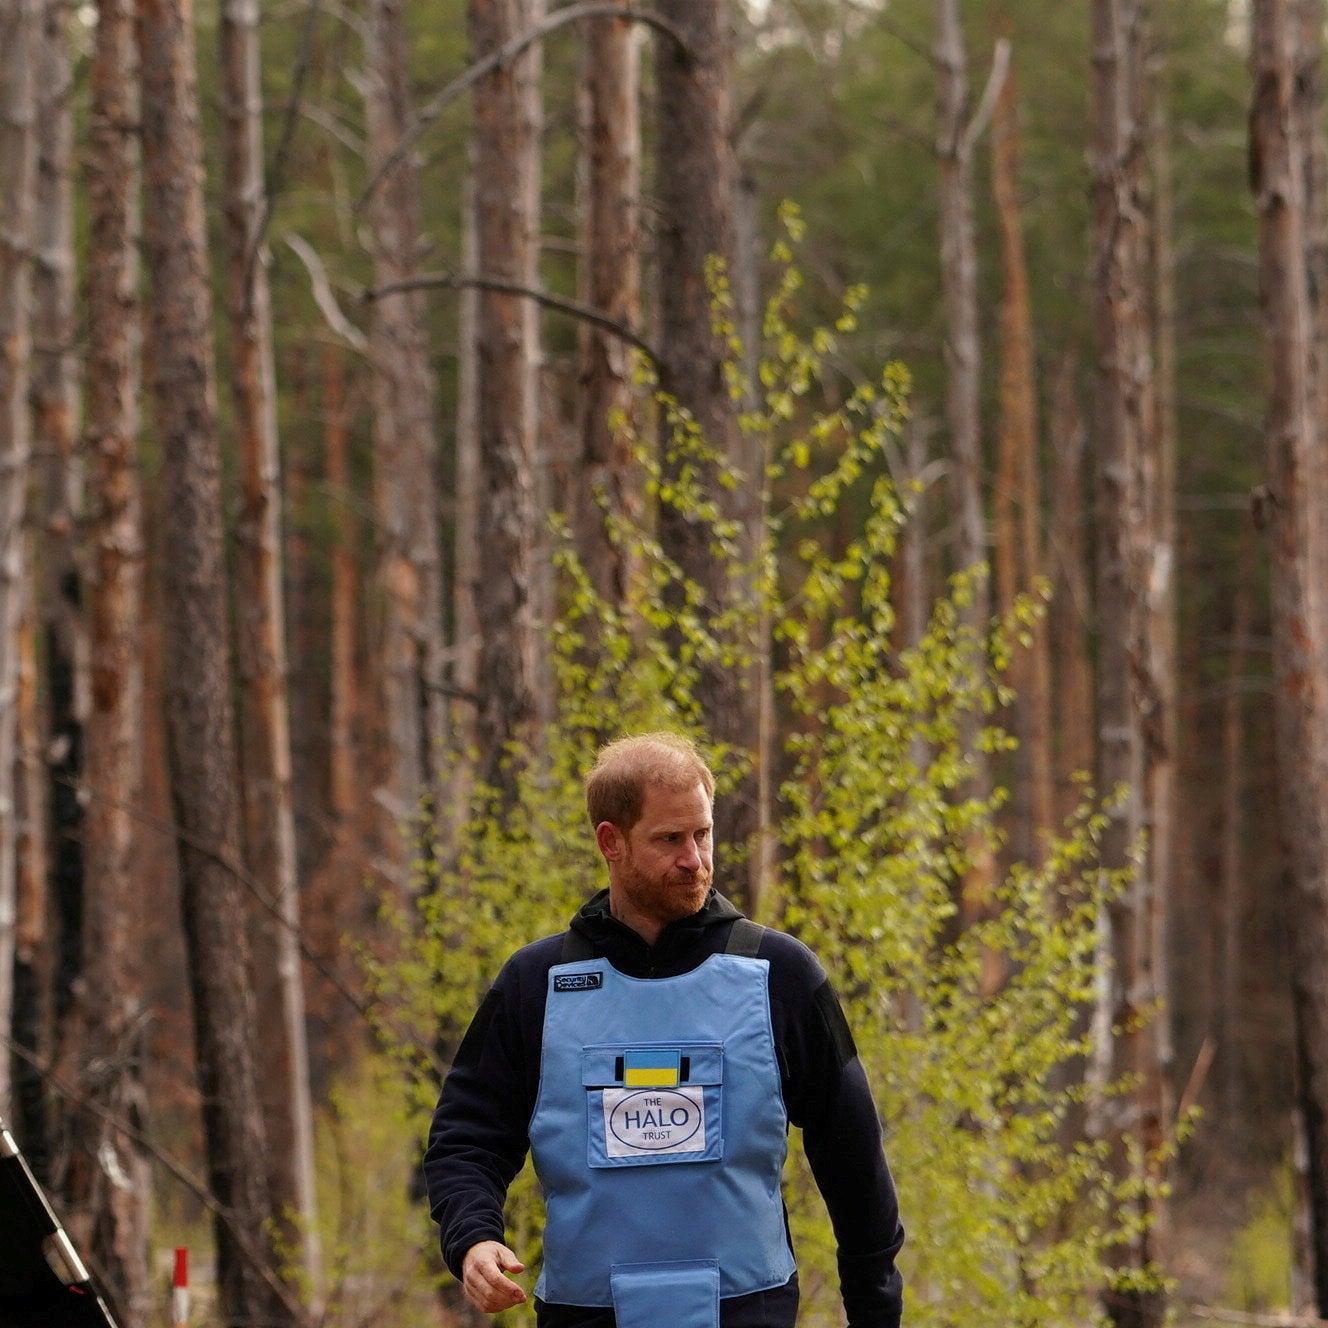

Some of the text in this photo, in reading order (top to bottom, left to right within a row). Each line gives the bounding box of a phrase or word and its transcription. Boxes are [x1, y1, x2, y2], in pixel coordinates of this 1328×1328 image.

[643, 1098, 661, 1106] THE
[625, 1108, 689, 1129] HALO
[643, 1131, 671, 1140] TRUST
